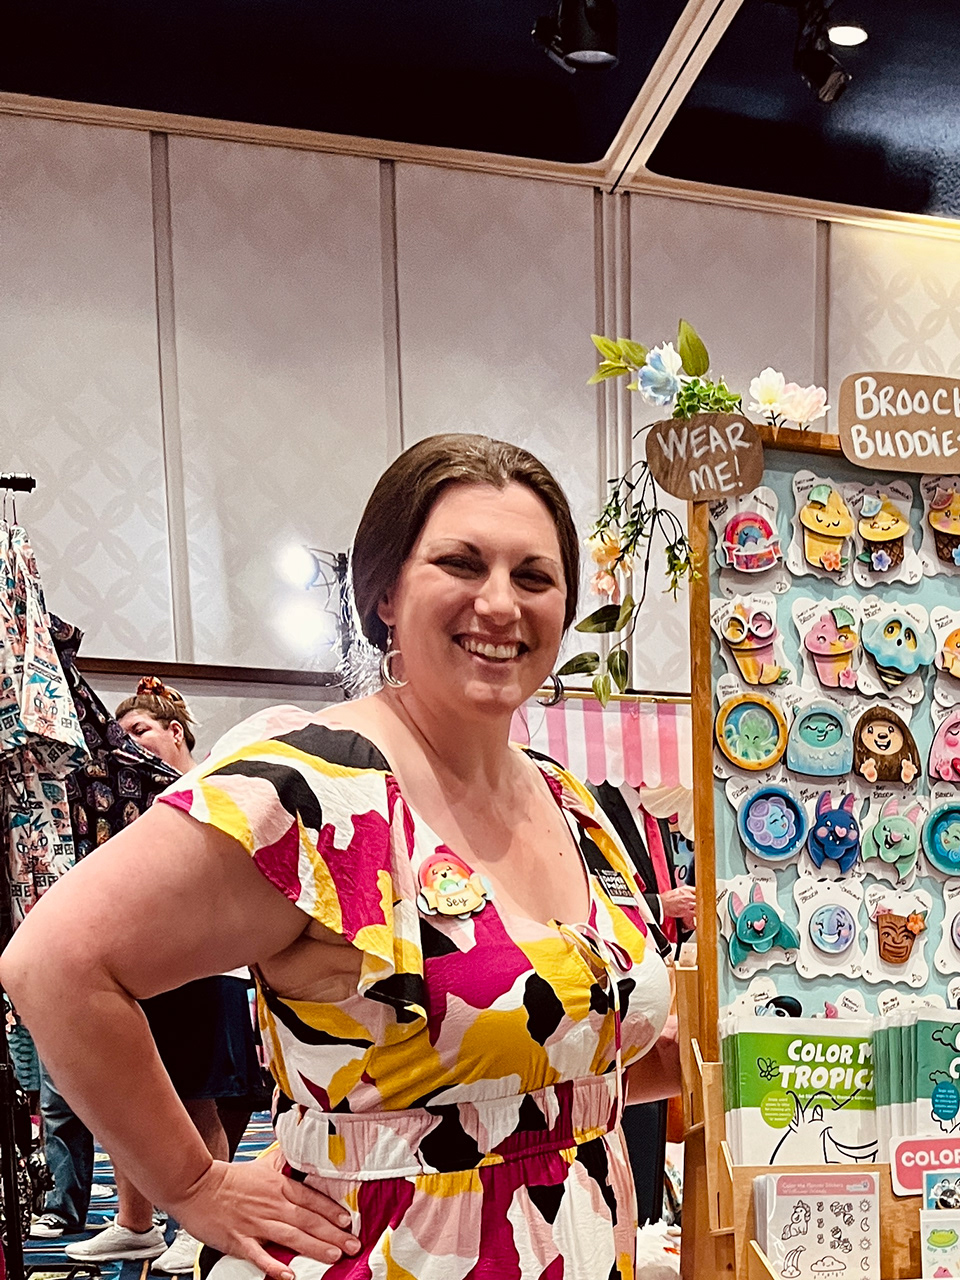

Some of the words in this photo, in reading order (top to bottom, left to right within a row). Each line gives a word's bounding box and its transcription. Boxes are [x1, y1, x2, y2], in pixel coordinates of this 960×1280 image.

[656, 422, 751, 462] WEAR
[689, 455, 744, 495] ME!
[446, 897, 469, 907] Sey
[787, 1039, 854, 1064] COLOR
